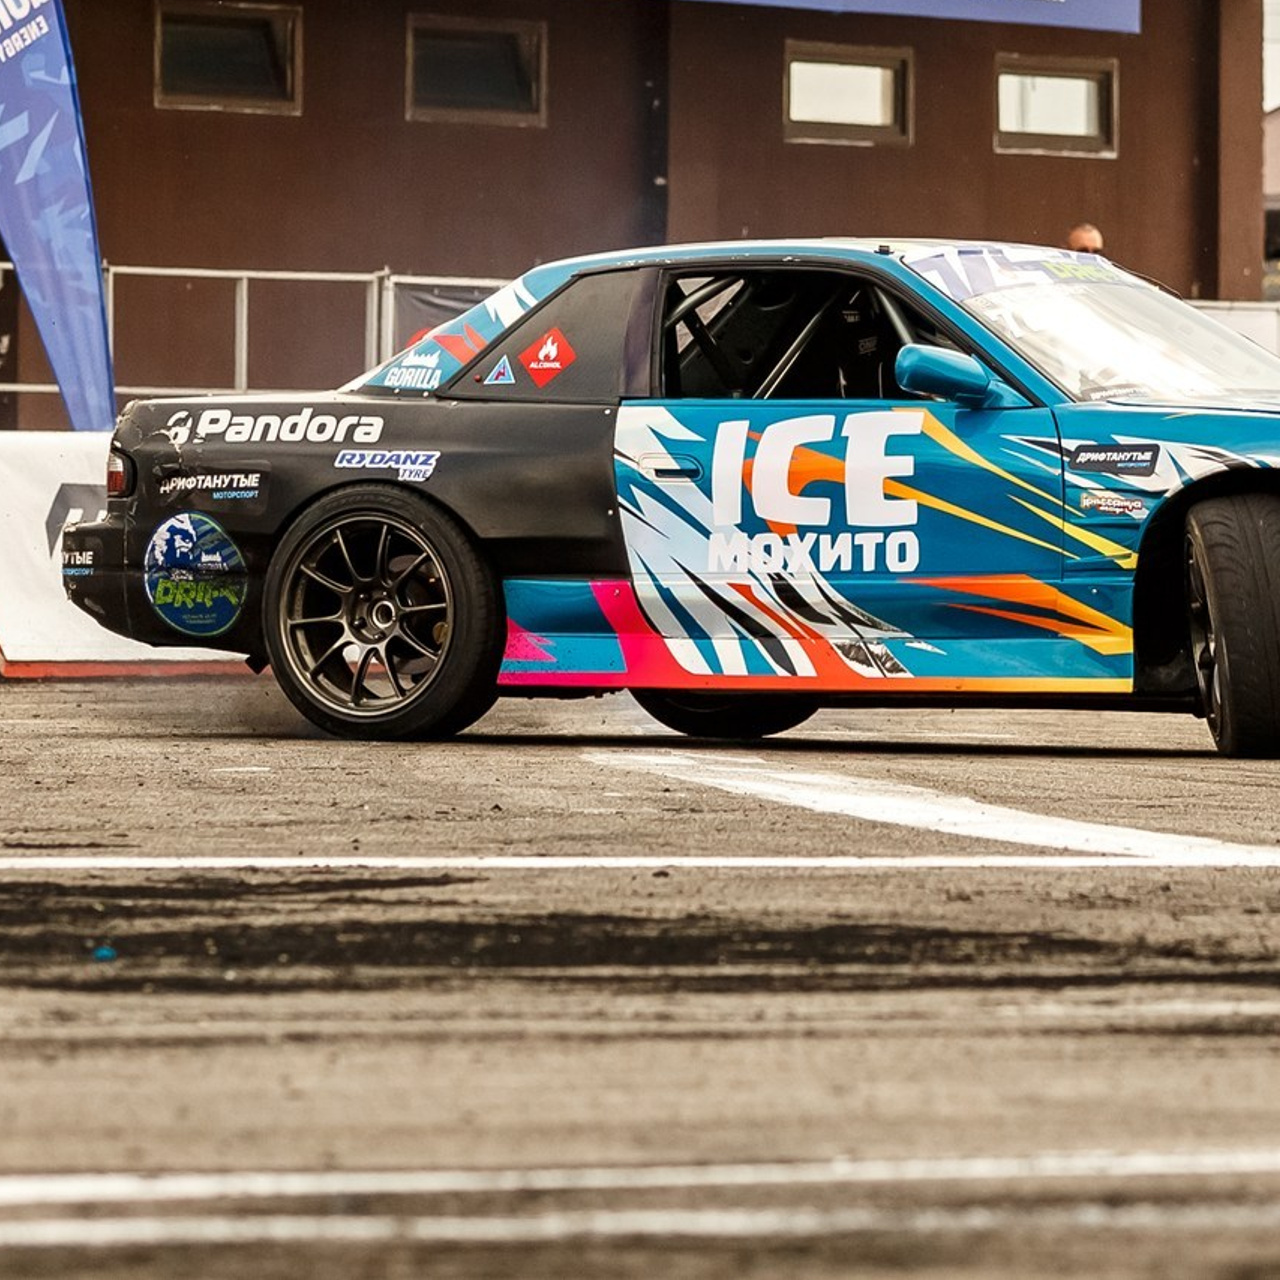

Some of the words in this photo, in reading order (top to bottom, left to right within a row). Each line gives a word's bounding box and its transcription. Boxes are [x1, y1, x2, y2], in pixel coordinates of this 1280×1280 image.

[385, 367, 443, 389] GORILLA
[194, 407, 384, 443] Pandora
[338, 452, 437, 467] RYDANZ
[1076, 451, 1154, 464] ДРИФТАНУТЫЕ
[400, 468, 430, 480] TYRE
[711, 411, 925, 527] ICE
[159, 473, 261, 494] ДРИФТАНУТЫЕ
[212, 489, 259, 500] МОТОРСПОРТ
[708, 531, 920, 572] МОХИТО
